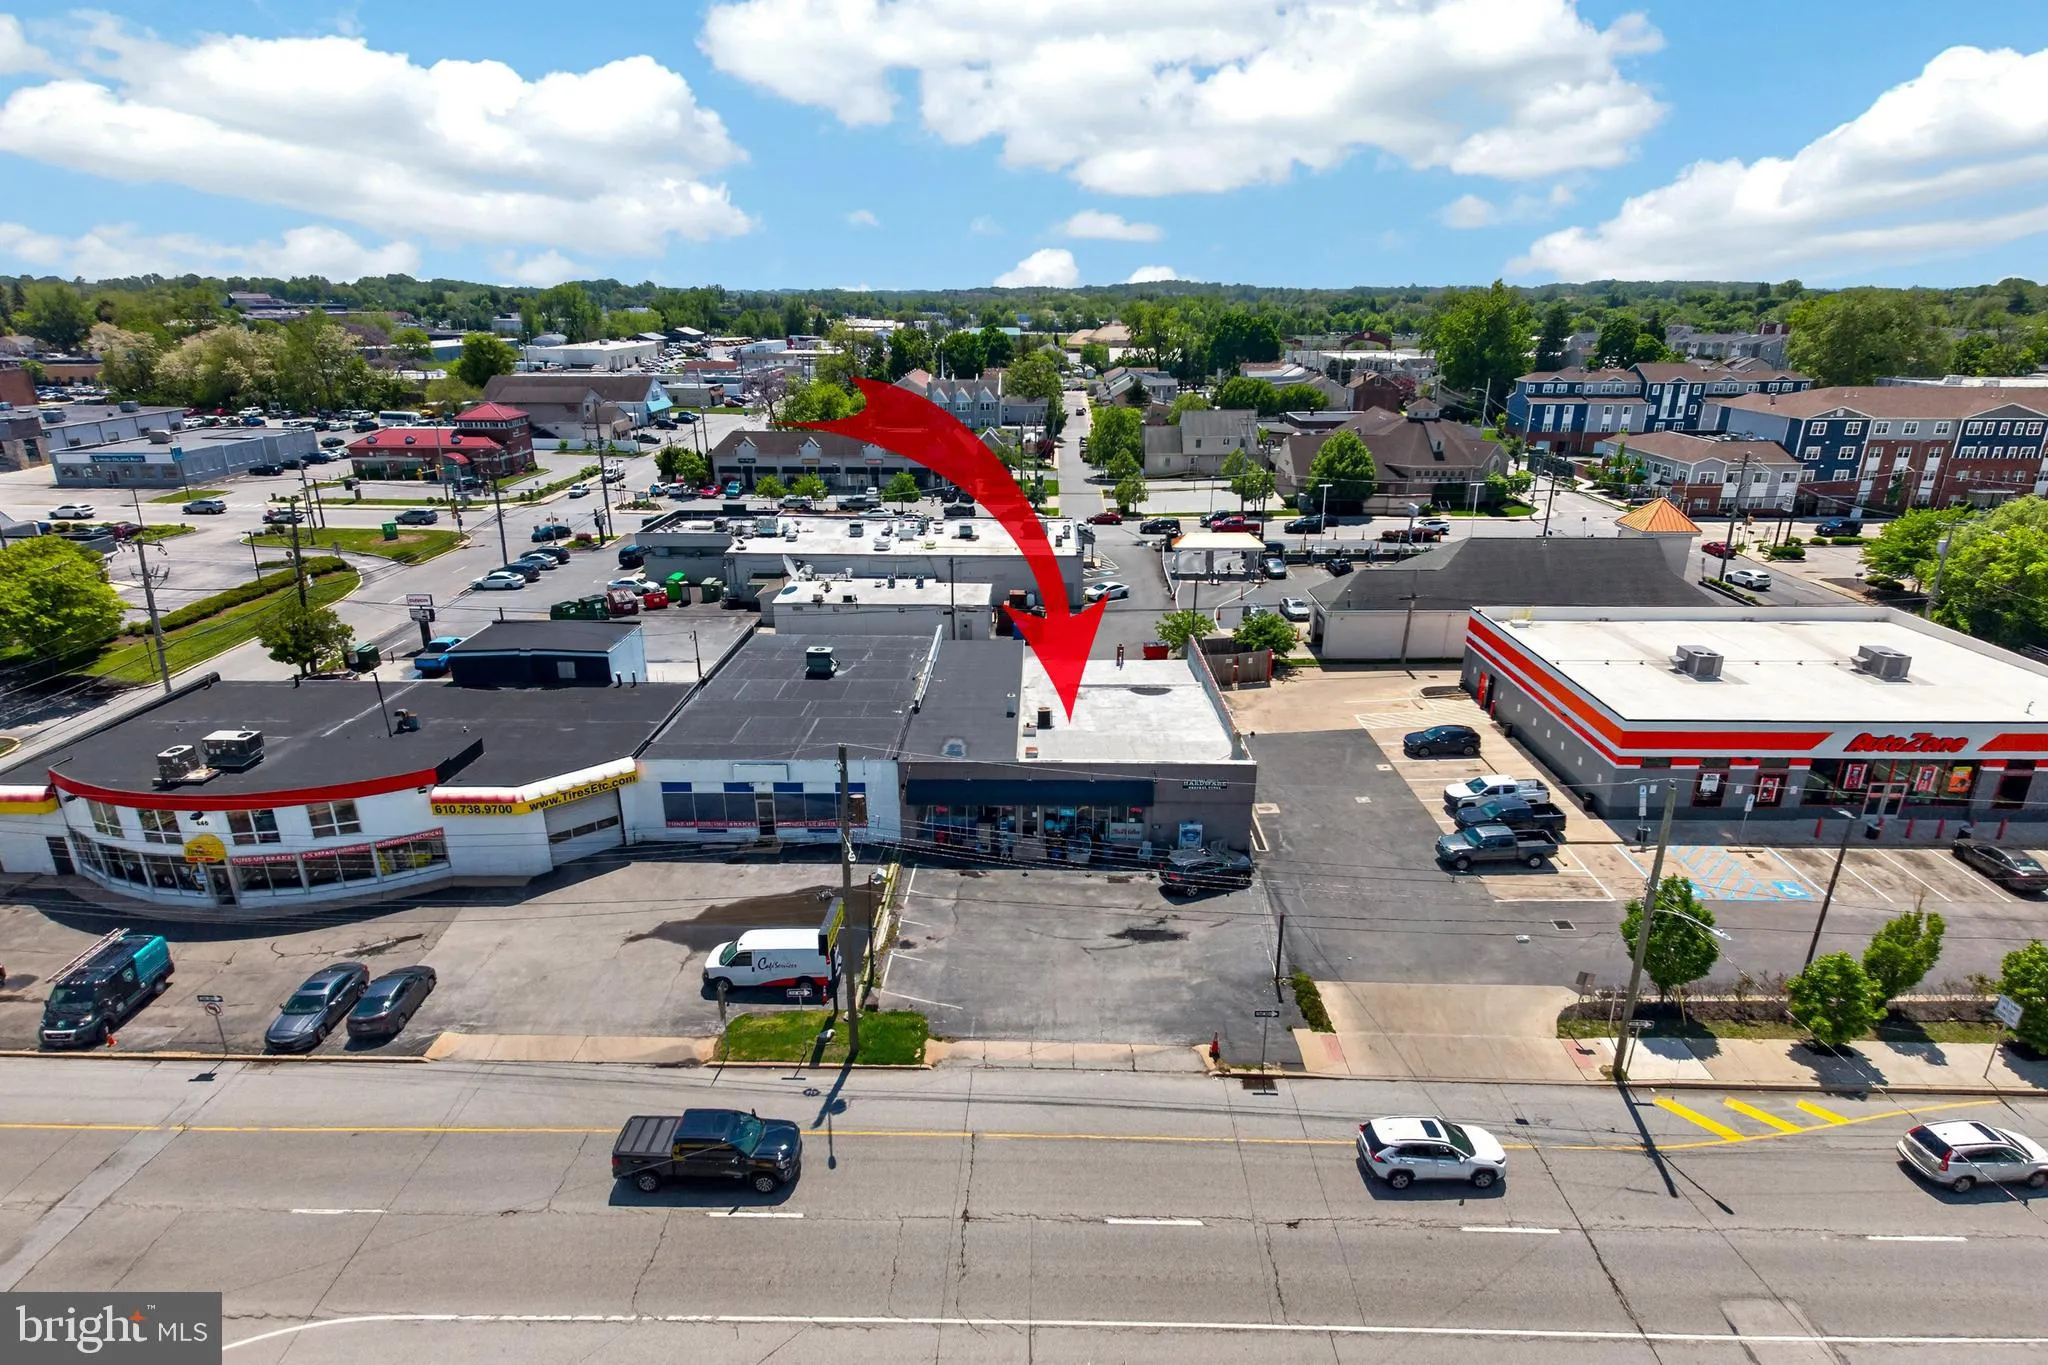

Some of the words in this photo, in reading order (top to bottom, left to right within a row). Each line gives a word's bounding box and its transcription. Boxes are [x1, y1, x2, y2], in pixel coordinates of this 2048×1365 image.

[1843, 732, 1969, 753] AutoZone
[528, 774, 637, 812] www.TiresEtc.com
[434, 804, 513, 815] 610.738.9700
